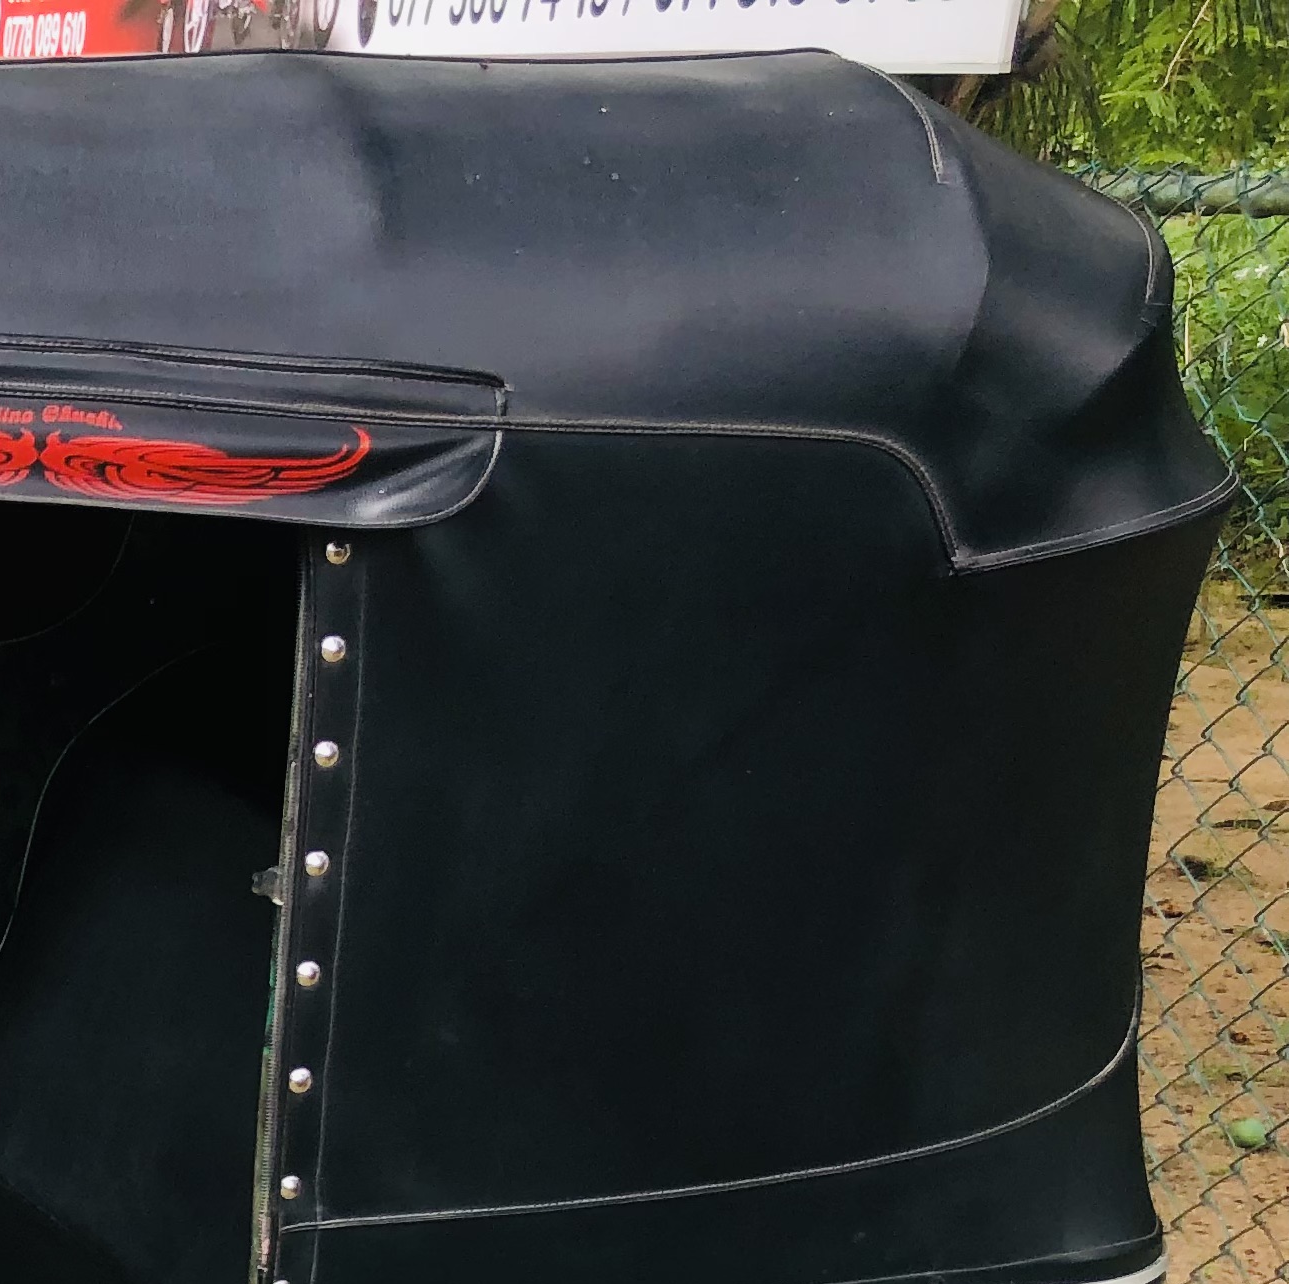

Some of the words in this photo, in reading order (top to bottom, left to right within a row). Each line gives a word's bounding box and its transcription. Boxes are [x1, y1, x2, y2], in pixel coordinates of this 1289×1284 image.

[3, 15, 34, 58] 0778
[35, 12, 61, 57] 089
[61, 11, 86, 56] 610
